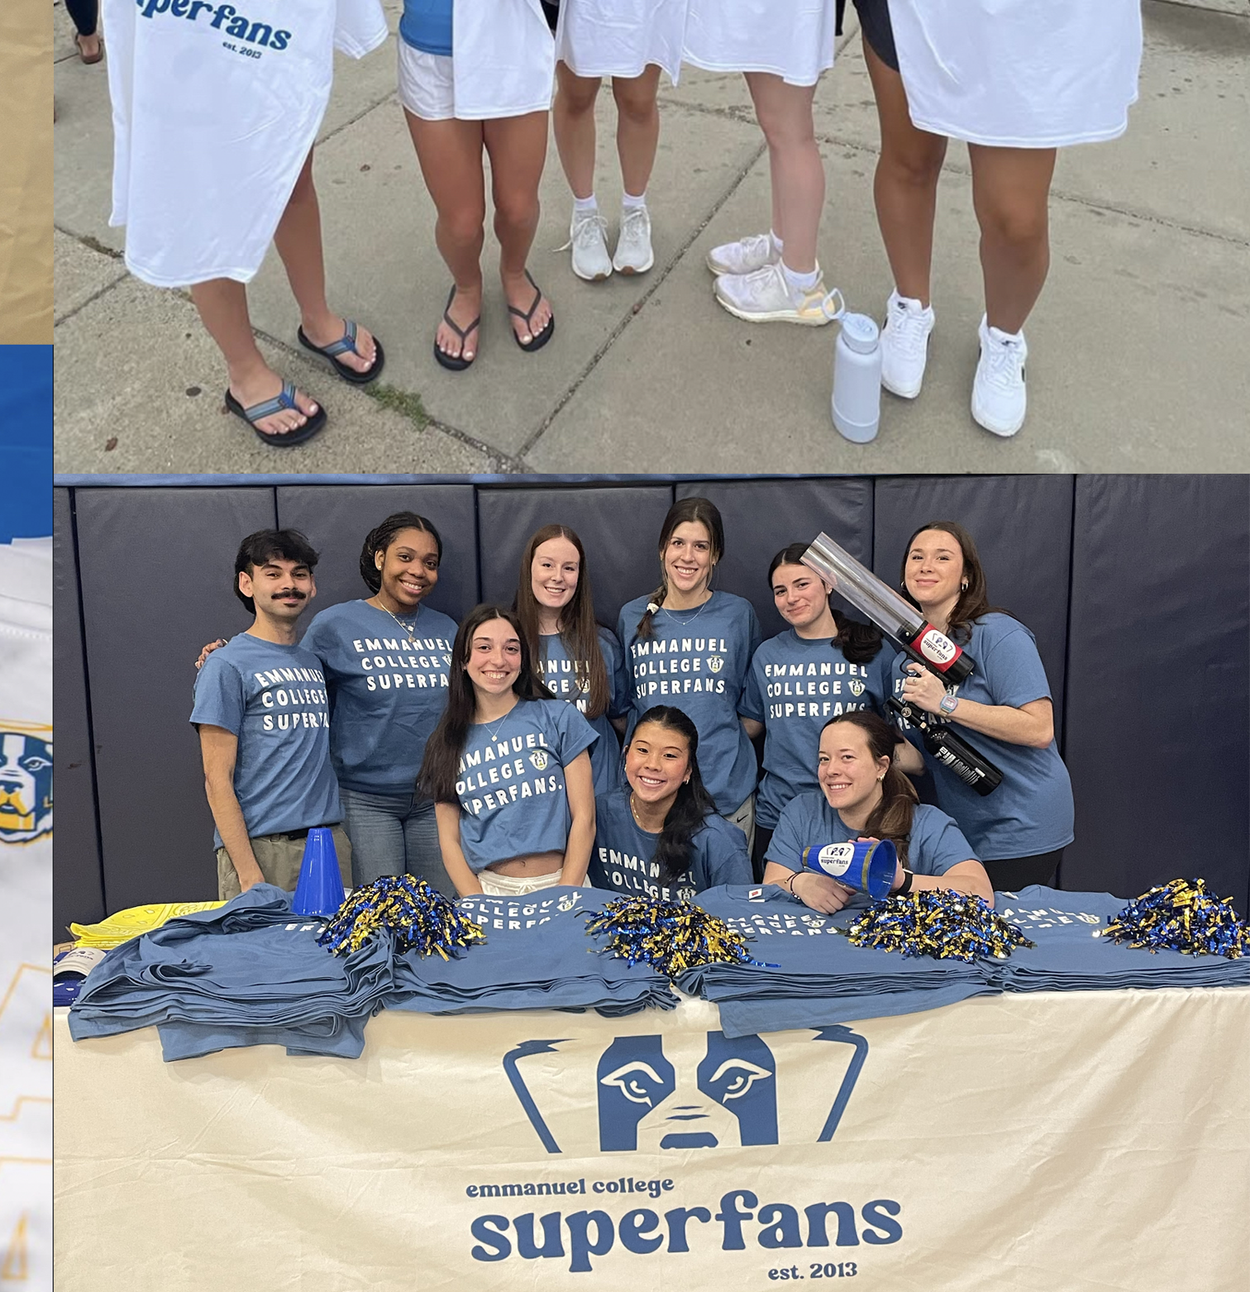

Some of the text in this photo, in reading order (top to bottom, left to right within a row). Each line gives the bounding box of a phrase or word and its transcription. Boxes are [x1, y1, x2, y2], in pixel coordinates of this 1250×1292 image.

[239, 45, 263, 59] 2013
[353, 638, 453, 653] EMMANUEL
[630, 638, 728, 659] EMMANUEL
[361, 655, 441, 670] COLLEGE
[633, 658, 701, 679] COLLEGE
[765, 662, 868, 678] EMMANUEL
[262, 689, 326, 708] COLLEGE
[767, 680, 842, 698] COLLEGE
[465, 1176, 675, 1199] emmanuel college
[470, 1189, 904, 1273] superfans
[767, 1261, 859, 1281] est. 2013
